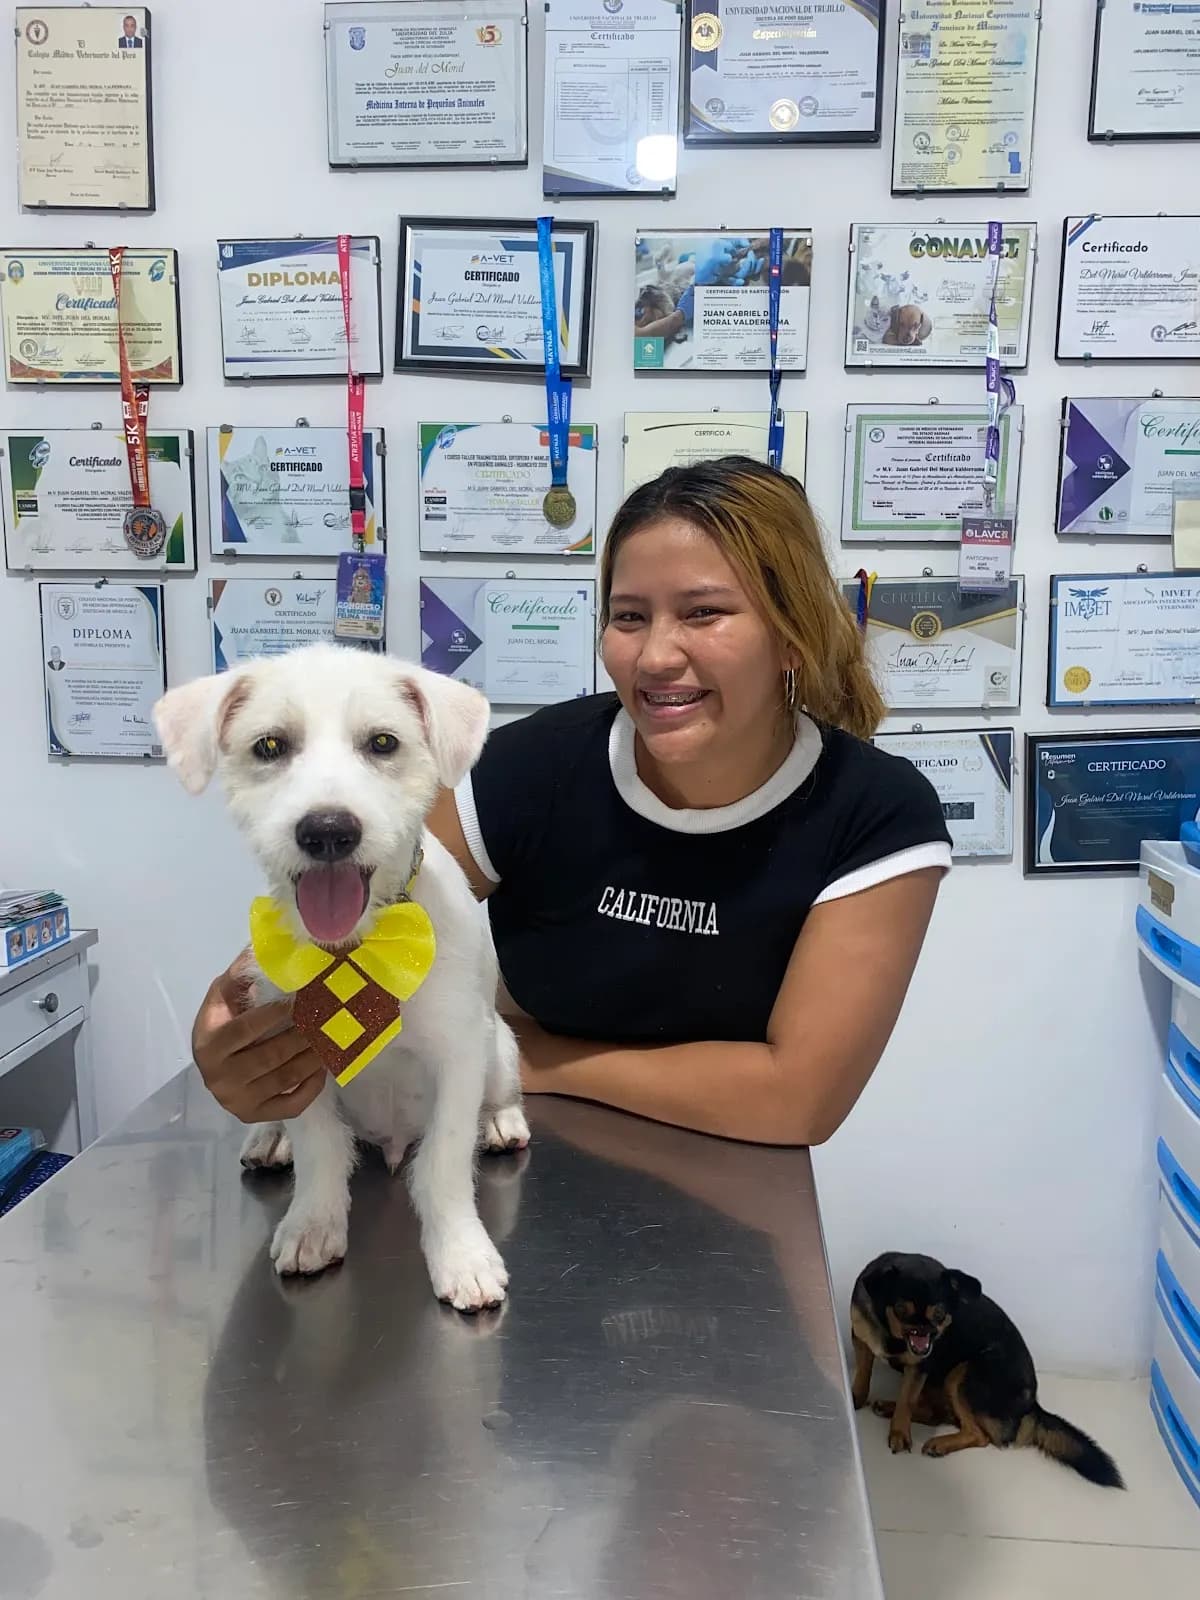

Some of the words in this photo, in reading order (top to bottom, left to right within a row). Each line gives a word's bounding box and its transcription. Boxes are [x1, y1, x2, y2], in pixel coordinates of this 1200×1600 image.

[725, 7, 768, 15] UNIVERSIDAD
[770, 6, 801, 14] NACIONAL
[804, 5, 812, 13] DE
[814, 5, 845, 13] TRUJILLO
[591, 32, 634, 40] Certificado
[385, 62, 414, 78] Juan
[416, 62, 429, 74] del
[431, 61, 465, 74] Moral
[366, 100, 393, 110] Medicina
[395, 100, 417, 109] Interna
[418, 100, 425, 109] de
[427, 98, 456, 110] Pequeños
[457, 98, 485, 108] Animales
[1082, 241, 1148, 252] Certificado
[111, 253, 121, 274] 5K
[480, 255, 514, 264] A-VET
[247, 272, 341, 287] DIPLOMA
[464, 271, 520, 282] CERTIFICADO
[1080, 269, 1097, 279] Del
[1099, 268, 1128, 279] Moral
[1128, 268, 1172, 280] Valderrama
[427, 292, 446, 304] Juan
[447, 292, 475, 305] Gabriel
[475, 293, 492, 304] Del
[127, 424, 139, 444] 5K
[1140, 414, 1200, 445] Certifi
[69, 456, 122, 468] Certificado
[925, 453, 971, 461] Certificado
[270, 462, 323, 472] CERTIFICADO
[476, 470, 530, 479] CERTIFICADO
[974, 530, 1000, 538] LAVC
[1161, 589, 1192, 597] IMVET
[487, 592, 578, 621] Certificado
[73, 629, 132, 639] DIPLOMA
[1041, 751, 1076, 761] Resumen
[911, 759, 958, 767] IFICADO
[1088, 760, 1166, 772] CERTIFICADO
[1055, 795, 1078, 807] Juan
[1079, 793, 1105, 806] Gabriel
[1106, 792, 1125, 802] Del
[1125, 792, 1152, 803] Moral
[1153, 790, 1196, 801] Valderrama
[598, 886, 719, 935] CALIFORNIA
